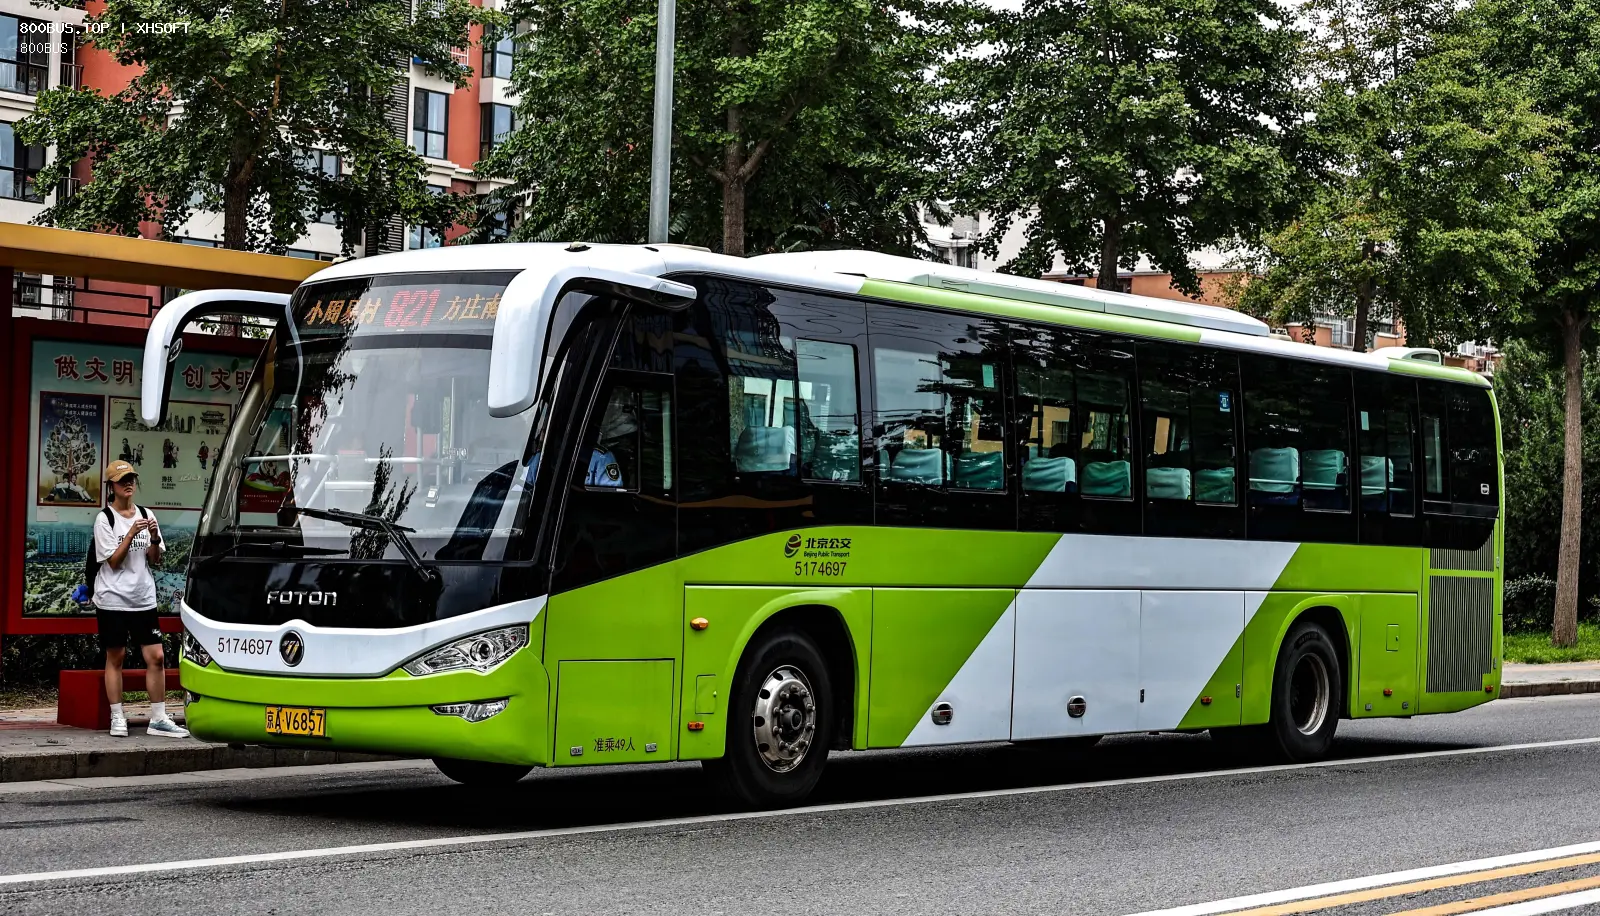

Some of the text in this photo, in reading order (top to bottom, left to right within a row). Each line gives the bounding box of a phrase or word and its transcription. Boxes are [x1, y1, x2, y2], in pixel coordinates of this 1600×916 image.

[384, 289, 441, 327] 821
[54, 354, 135, 385] 做文明
[804, 537, 852, 549] 北京公交
[830, 550, 850, 558] Transport
[794, 561, 847, 576] 5174697
[266, 590, 338, 606] FOTON
[217, 637, 273, 656] 5174697
[593, 736, 636, 753] 准乘49人
